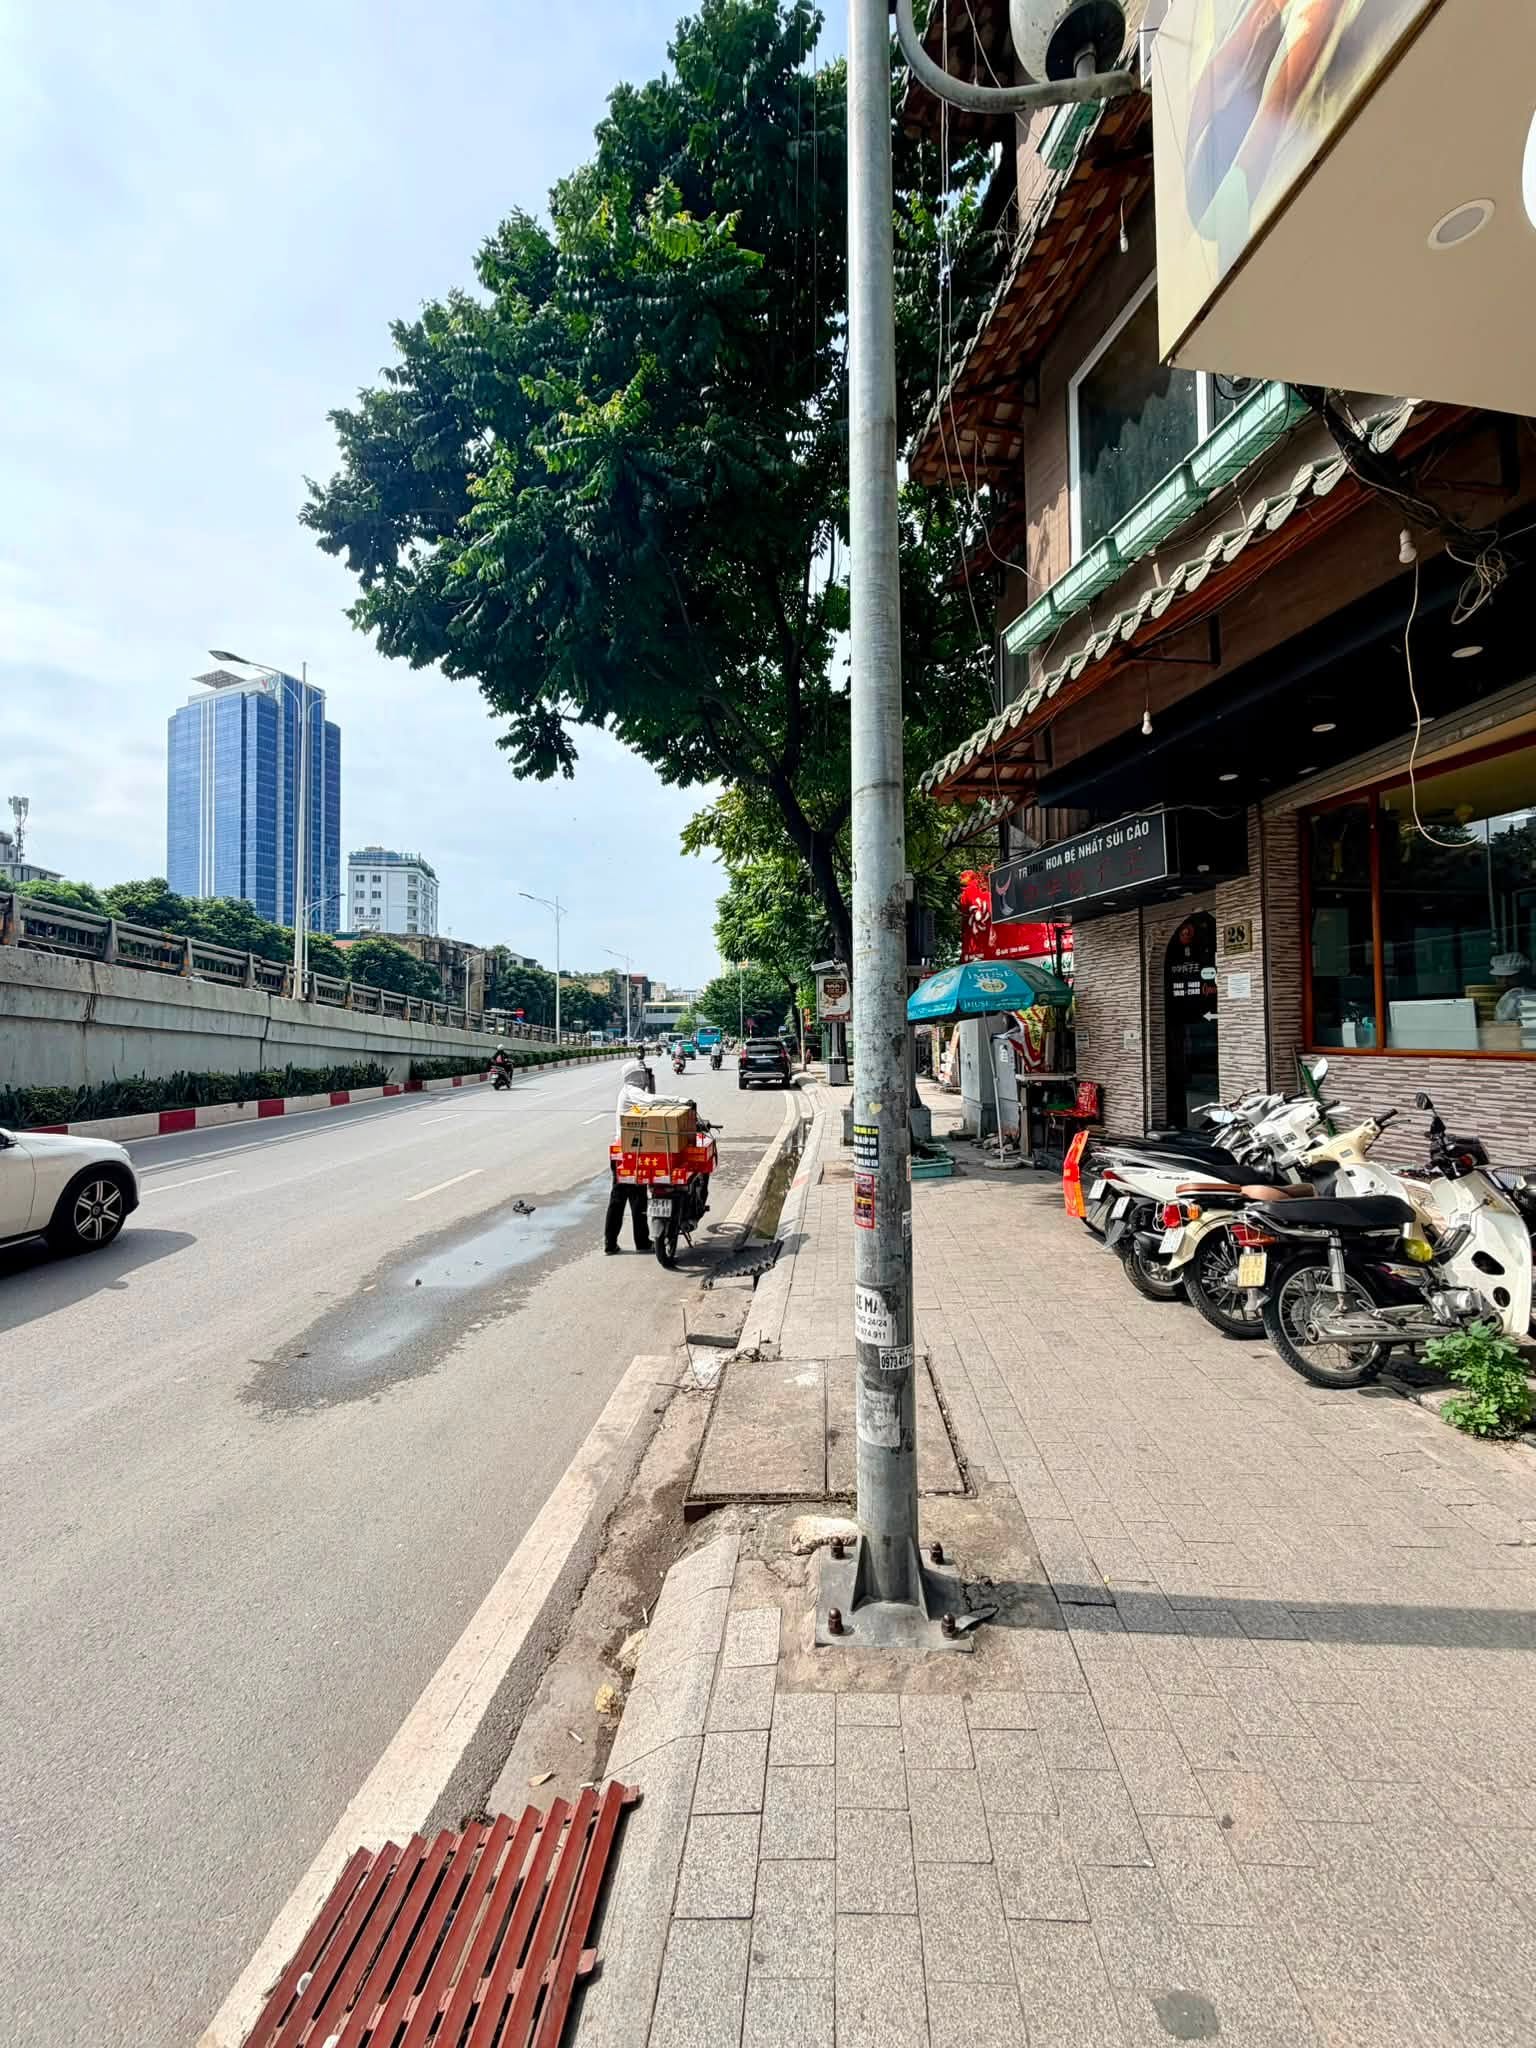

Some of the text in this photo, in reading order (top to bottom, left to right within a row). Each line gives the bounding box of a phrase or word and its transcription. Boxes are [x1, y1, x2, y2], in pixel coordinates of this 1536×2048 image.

[1045, 855, 1063, 872] HOA
[1064, 848, 1076, 864] ĐỆ
[1078, 834, 1104, 858] NHẤT
[1227, 925, 1245, 943] 28
[868, 1316, 888, 1328] 24/24
